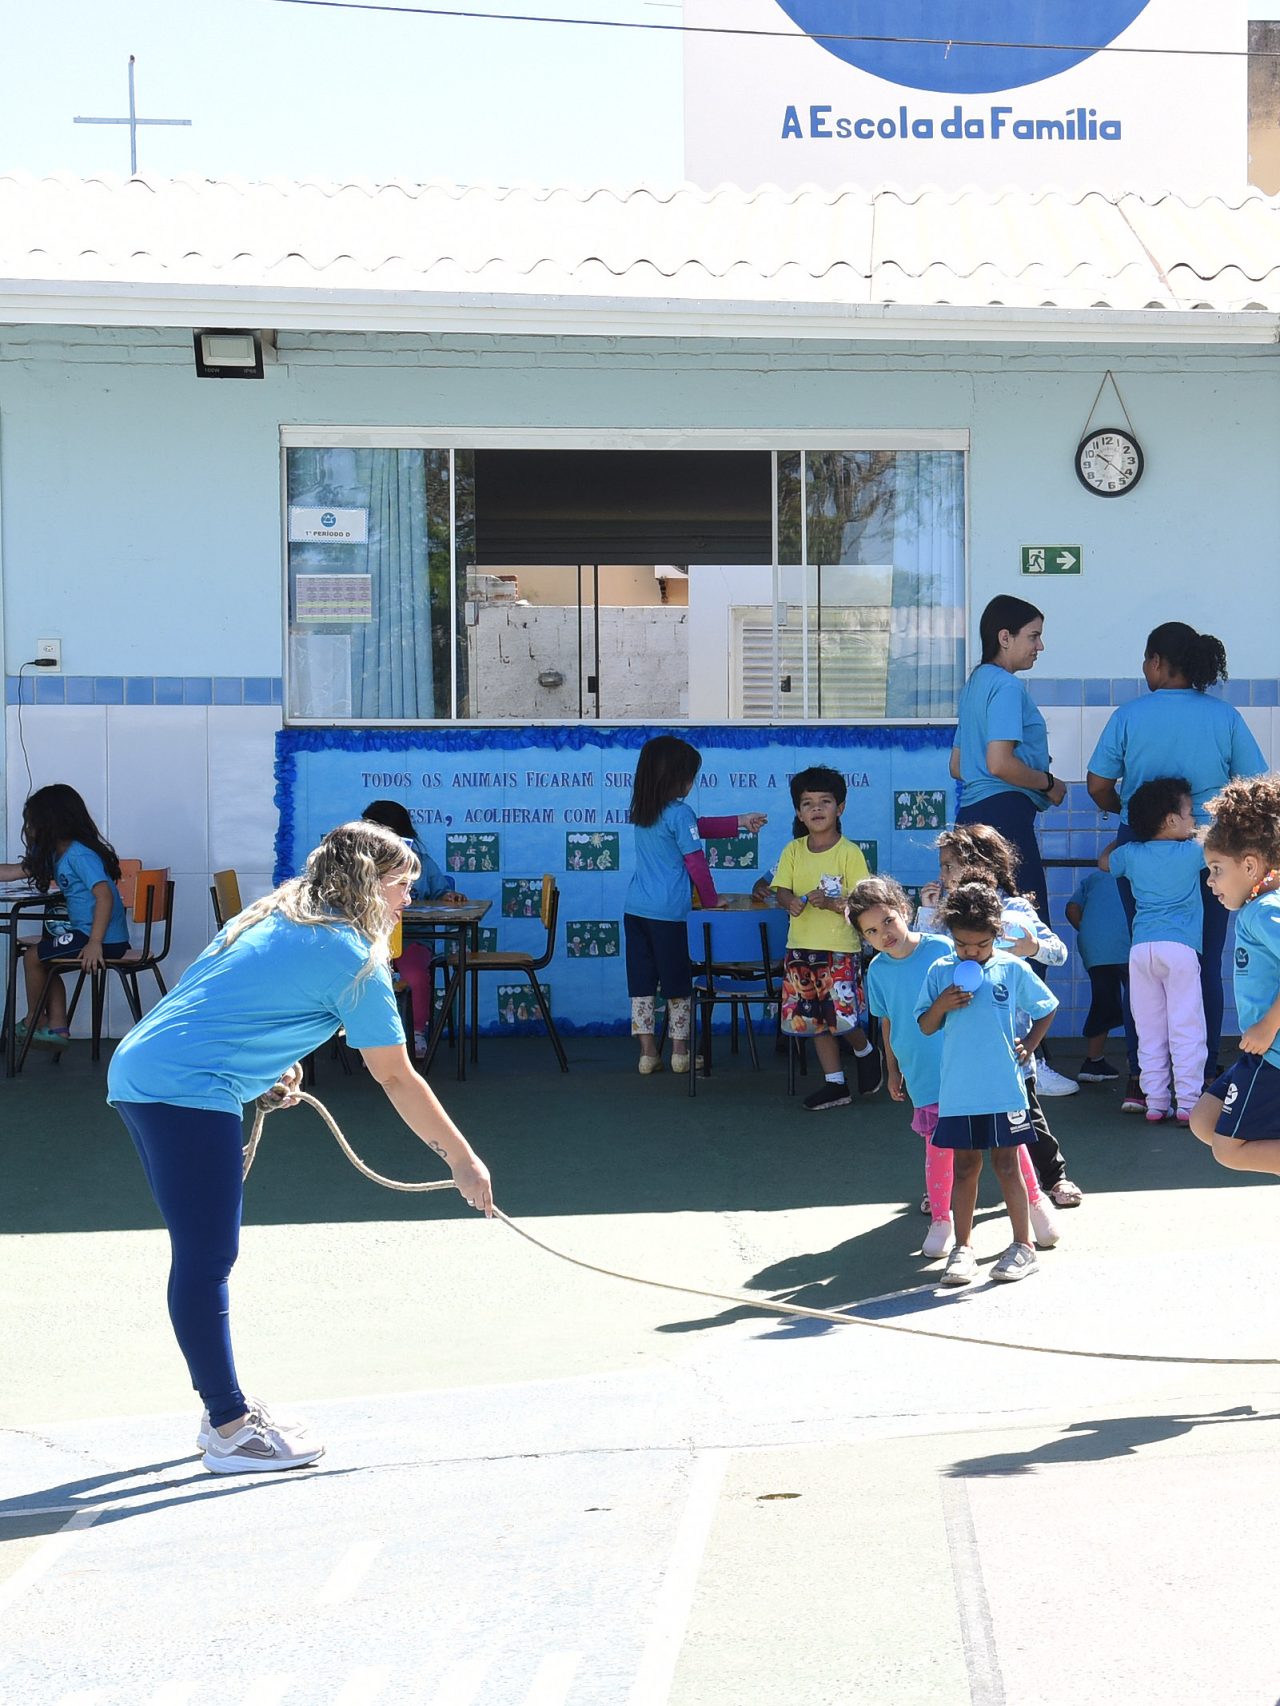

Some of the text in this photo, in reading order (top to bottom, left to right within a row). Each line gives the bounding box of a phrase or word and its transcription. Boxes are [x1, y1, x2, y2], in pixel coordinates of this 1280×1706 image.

[781, 105, 1122, 140] A Escola da Família
[1092, 441, 1099, 450] 11
[1101, 436, 1114, 446] 12
[1085, 449, 1095, 459] 10
[1122, 445, 1131, 455] 2
[1083, 461, 1092, 469] 9
[1127, 456, 1136, 465] 3
[1087, 471, 1096, 480] 8
[1124, 468, 1133, 476] 4
[1094, 479, 1104, 488] 7
[1107, 481, 1116, 490] 6
[1118, 477, 1127, 486] 5
[361, 772, 412, 788] TODOS
[422, 772, 442, 788] OS
[452, 772, 517, 788] ANIMAIS
[526, 771, 594, 788] FICARAM
[700, 773, 718, 788] AO
[729, 773, 757, 788] VER
[767, 773, 777, 788] A
[464, 808, 554, 824] ACOLHERAM
[563, 808, 597, 824] COM
